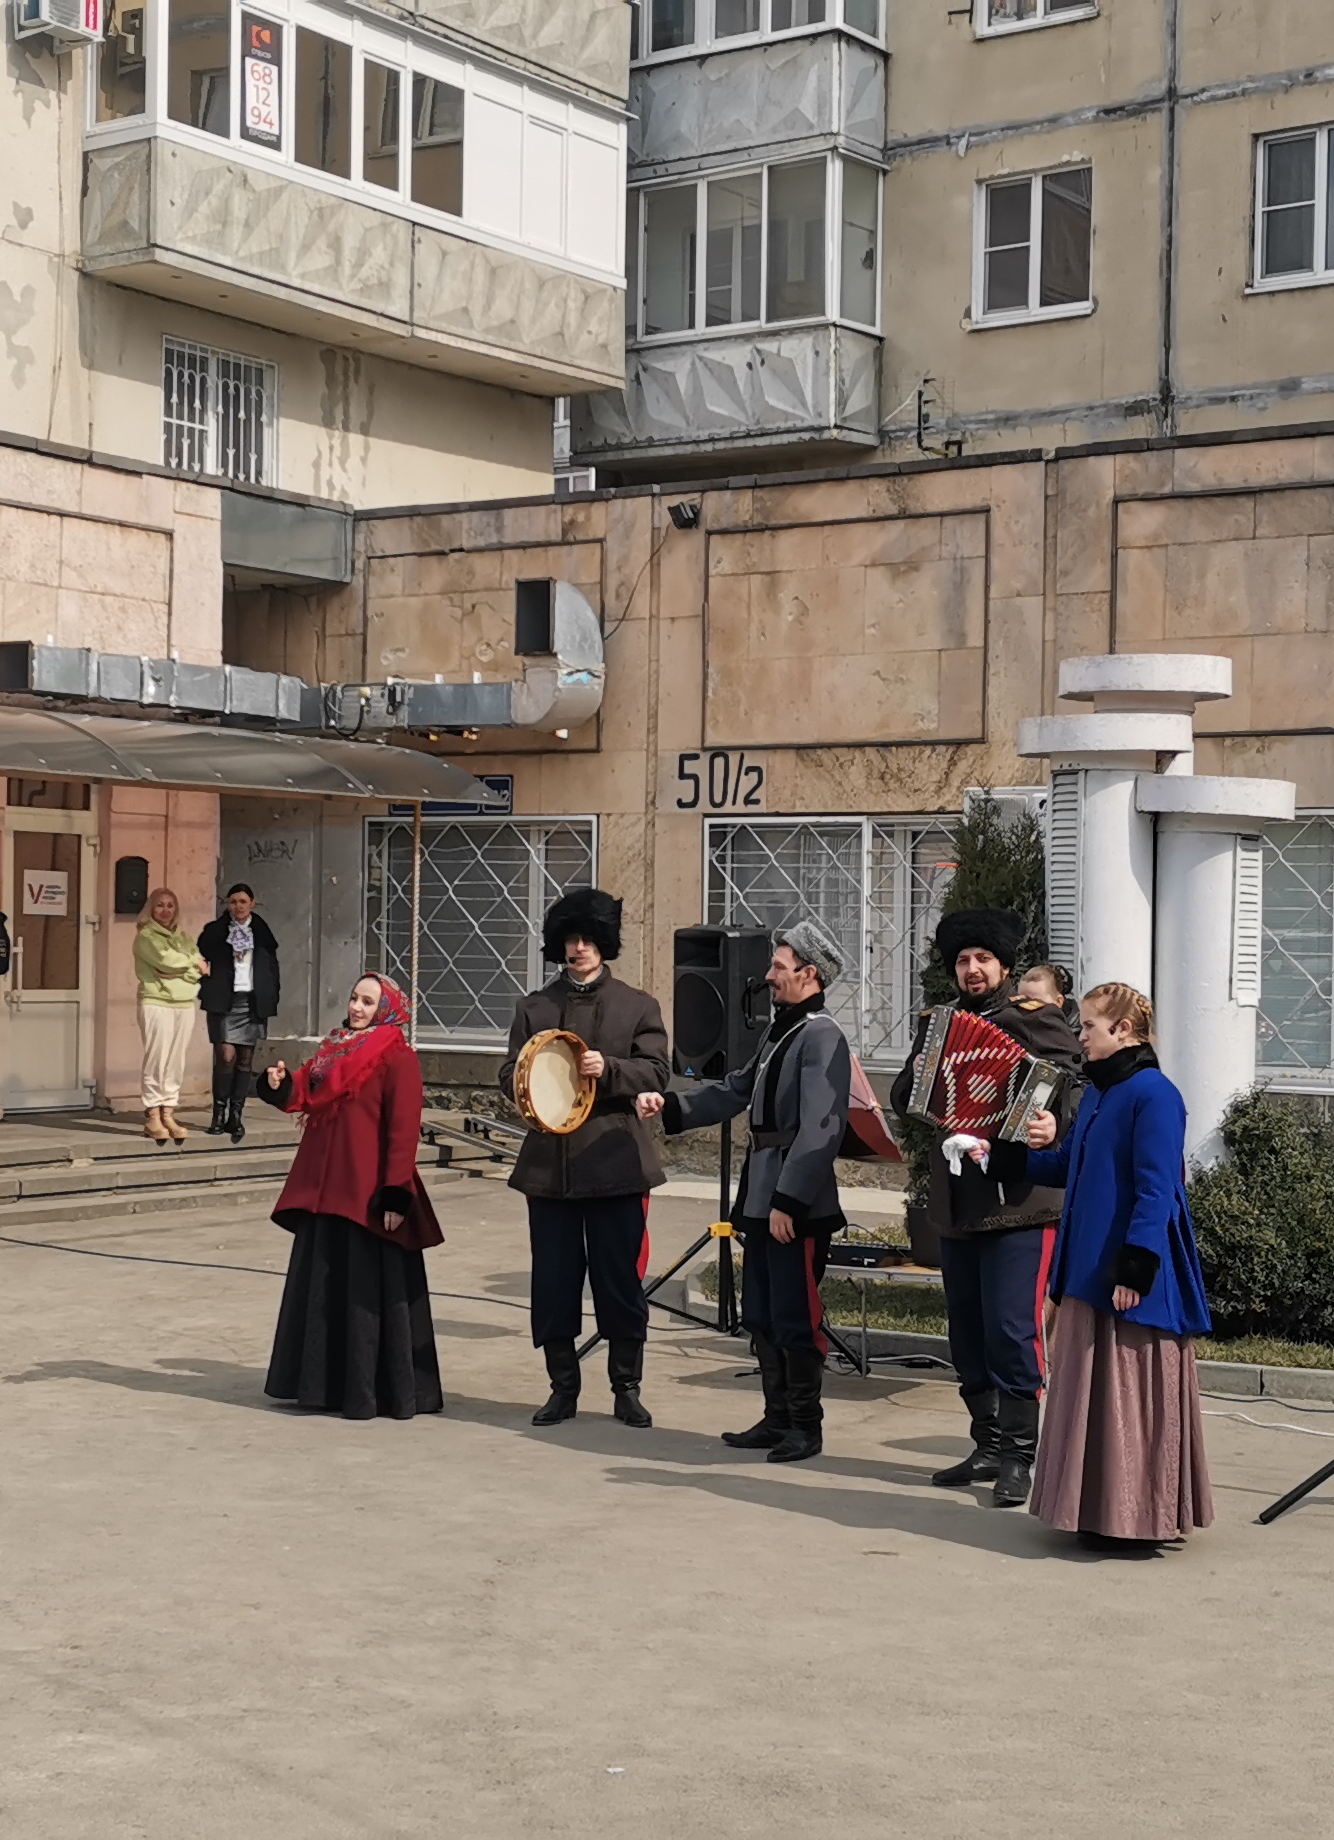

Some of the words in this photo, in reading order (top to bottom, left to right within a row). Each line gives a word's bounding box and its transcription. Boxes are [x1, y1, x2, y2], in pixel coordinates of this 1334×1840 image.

[250, 63, 273, 85] 68
[253, 84, 271, 107] 12
[250, 105, 275, 130] 94
[676, 751, 764, 809] 50/2
